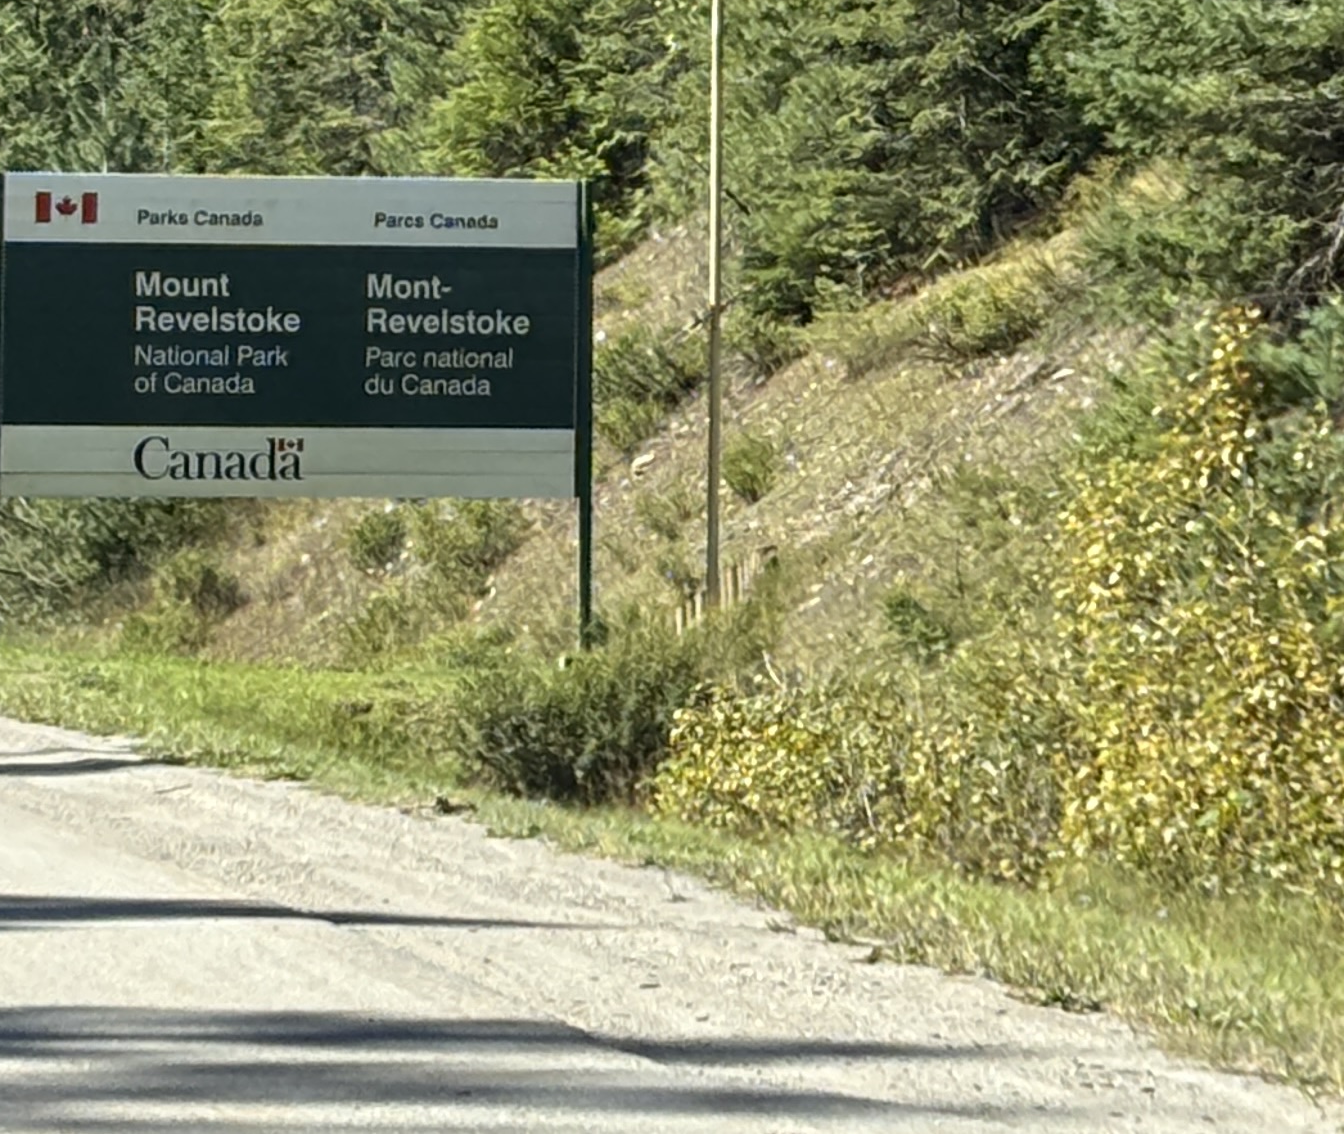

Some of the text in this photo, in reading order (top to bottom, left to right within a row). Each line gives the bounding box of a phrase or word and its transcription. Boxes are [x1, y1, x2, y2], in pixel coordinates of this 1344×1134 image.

[137, 210, 263, 227] Parks Canada
[374, 212, 498, 229] Parcs Canada
[136, 272, 229, 296] Mount
[368, 274, 451, 299] Mont-
[136, 306, 300, 332] Revelstoke
[368, 308, 529, 334] Revelstoke
[135, 345, 287, 366] National Park
[366, 346, 513, 368] Parc national
[135, 372, 255, 393] of Canada
[365, 374, 490, 395] du Canada
[134, 437, 303, 480] Canada
